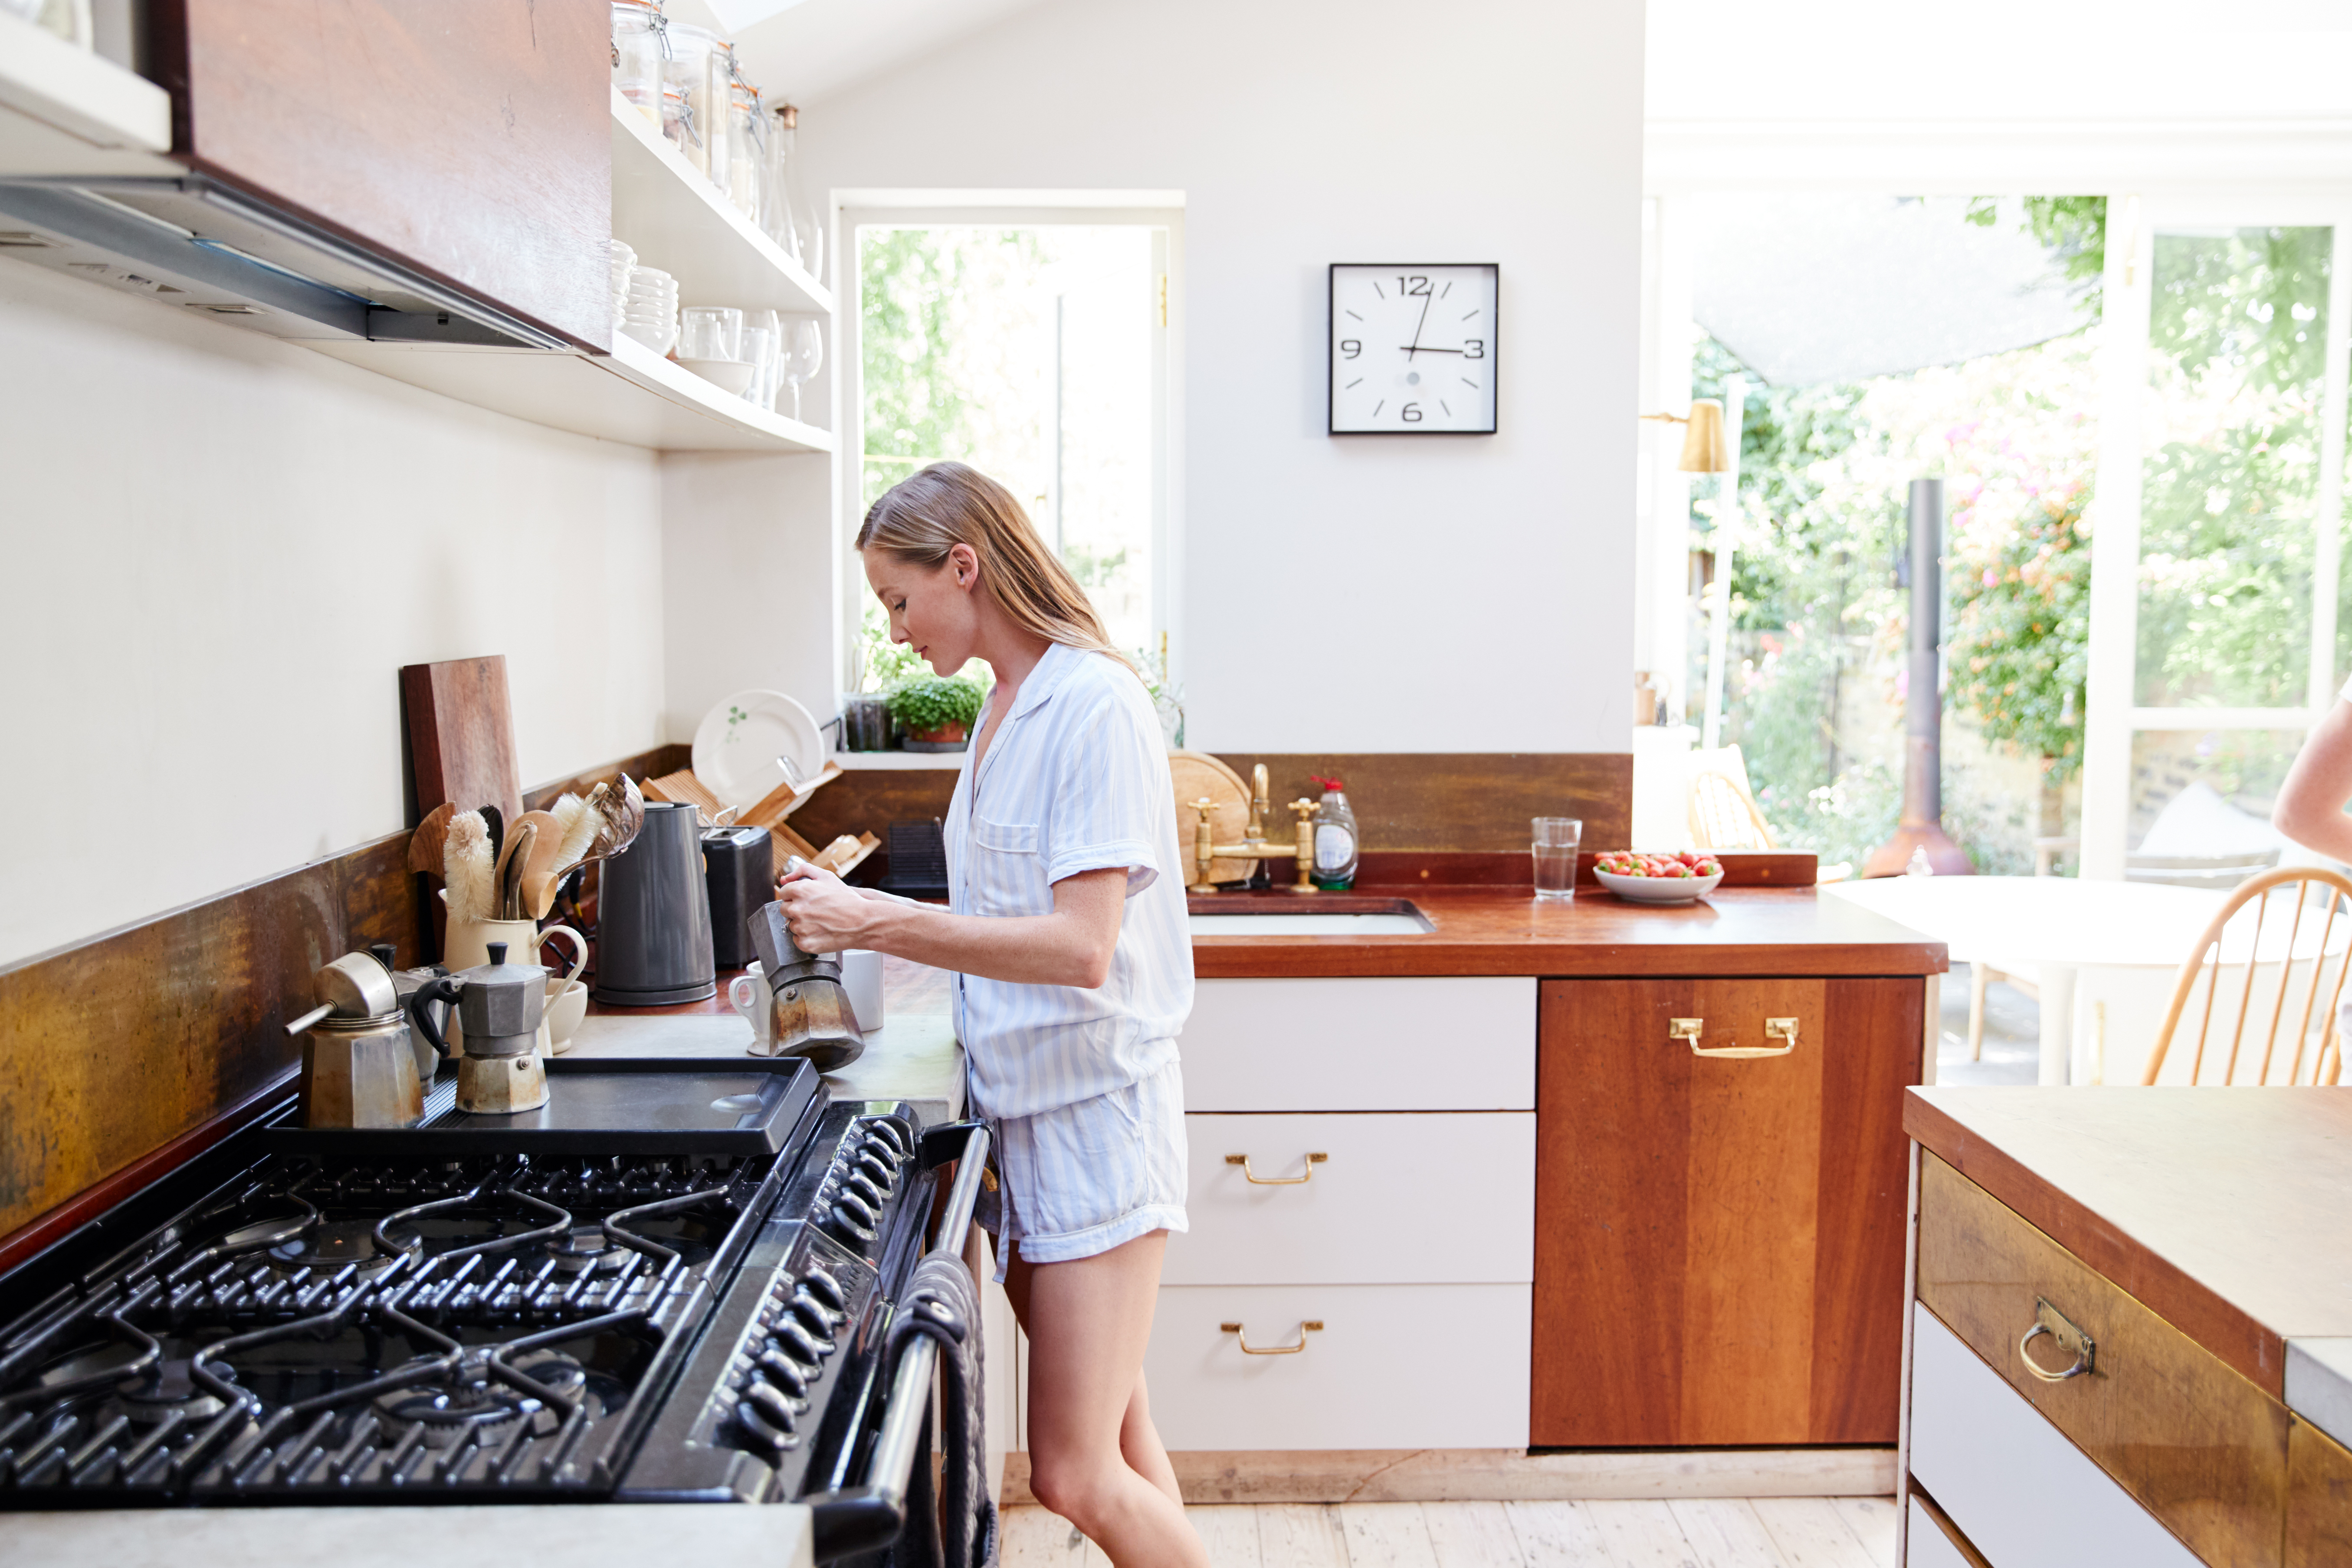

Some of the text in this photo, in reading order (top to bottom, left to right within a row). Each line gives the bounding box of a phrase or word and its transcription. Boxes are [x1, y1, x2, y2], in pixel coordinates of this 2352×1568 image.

[1397, 276, 1428, 296] 12
[1341, 340, 1361, 359] 9
[1464, 340, 1484, 358] 3
[1402, 403, 1422, 422] 6
